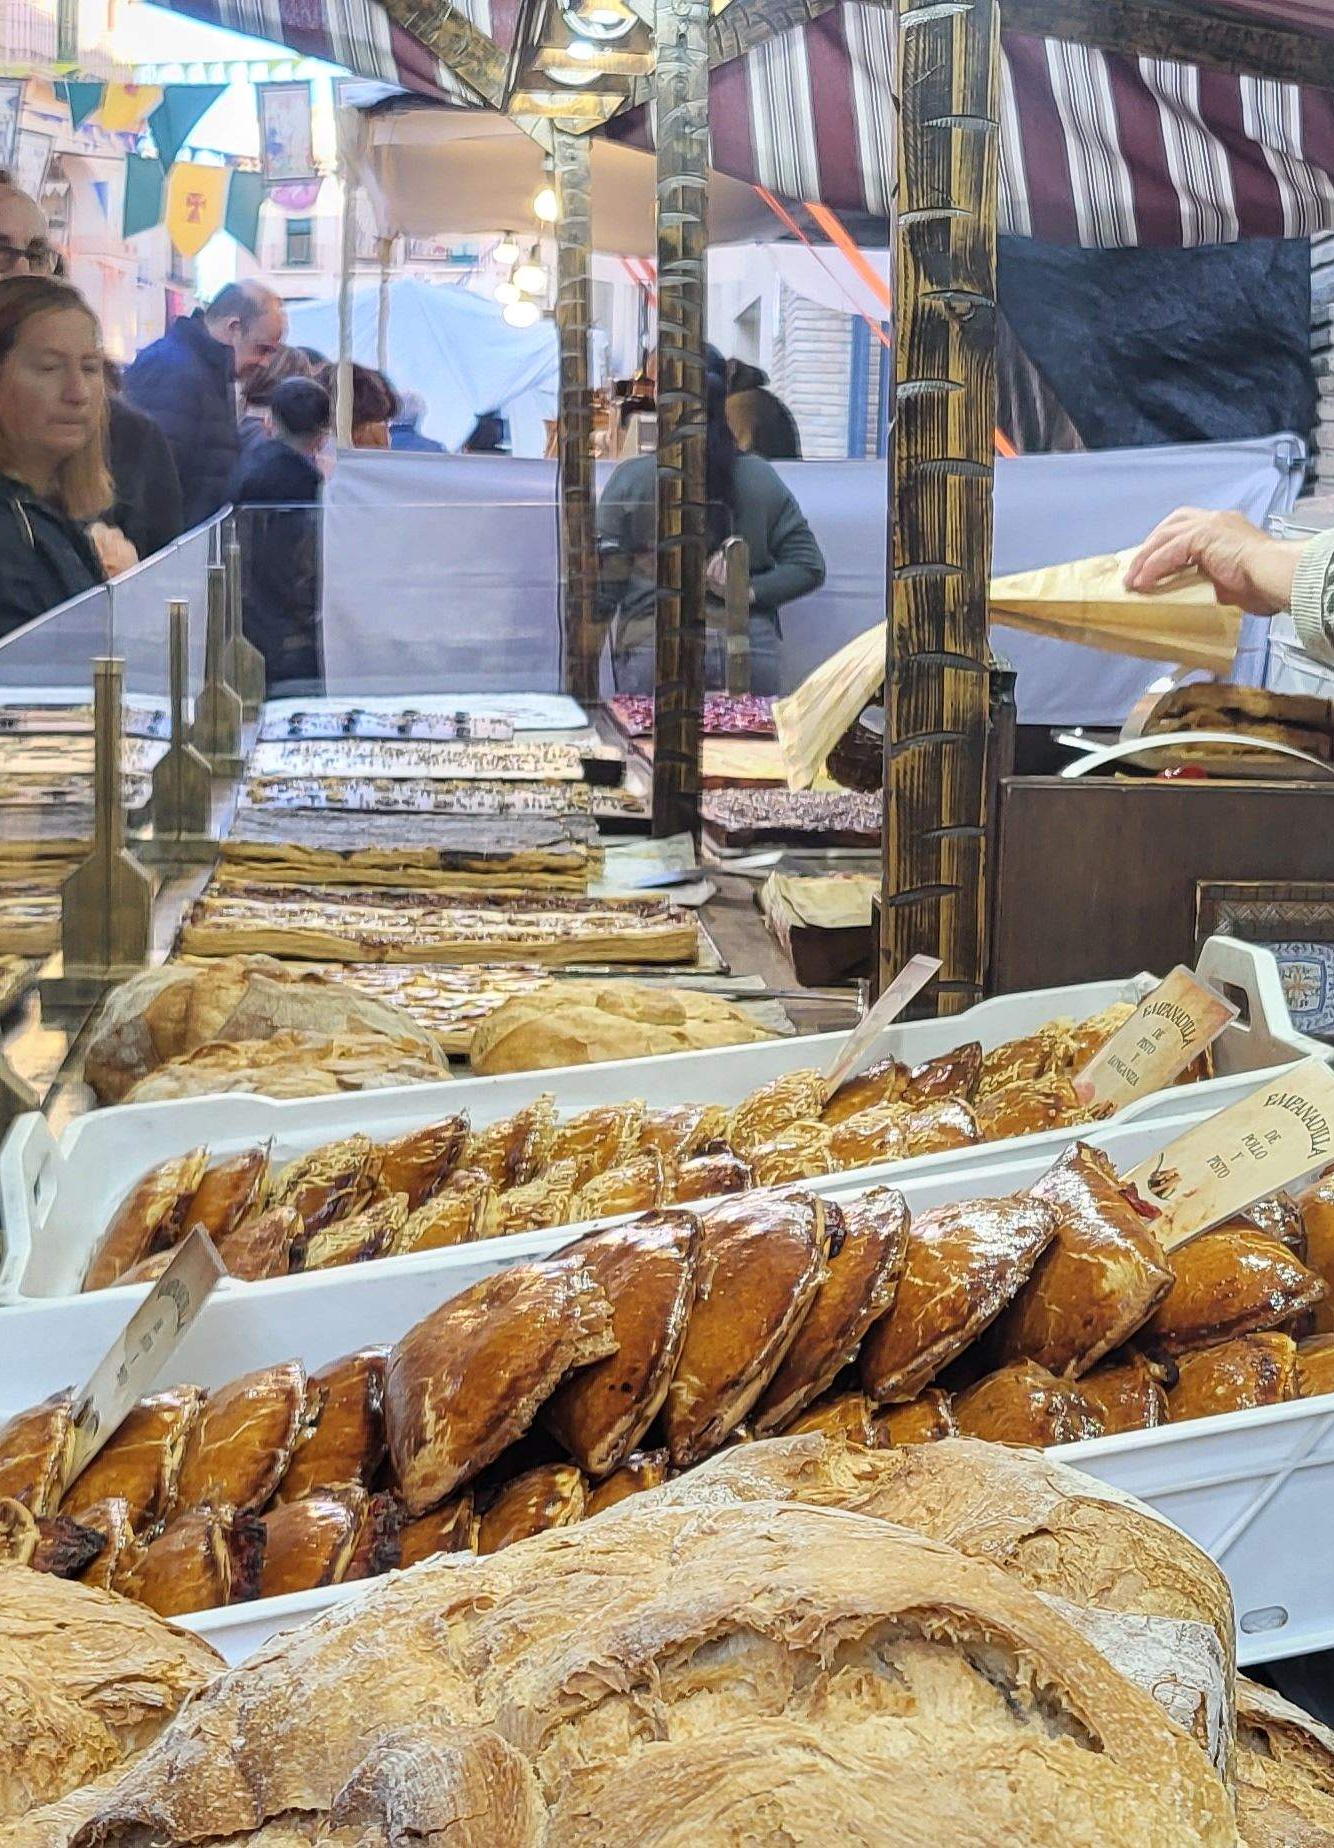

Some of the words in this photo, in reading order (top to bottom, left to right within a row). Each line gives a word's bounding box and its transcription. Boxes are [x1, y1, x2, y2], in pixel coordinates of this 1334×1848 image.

[1143, 1001, 1196, 1050] EMPANADILLA
[1152, 1028, 1166, 1040] DE
[1263, 1093, 1330, 1159] EMPANADILLA
[1264, 1129, 1281, 1144] DE
[1231, 1152, 1244, 1162] Y
[1241, 1133, 1268, 1159] POLLO
[1207, 1155, 1230, 1178] PISTO
